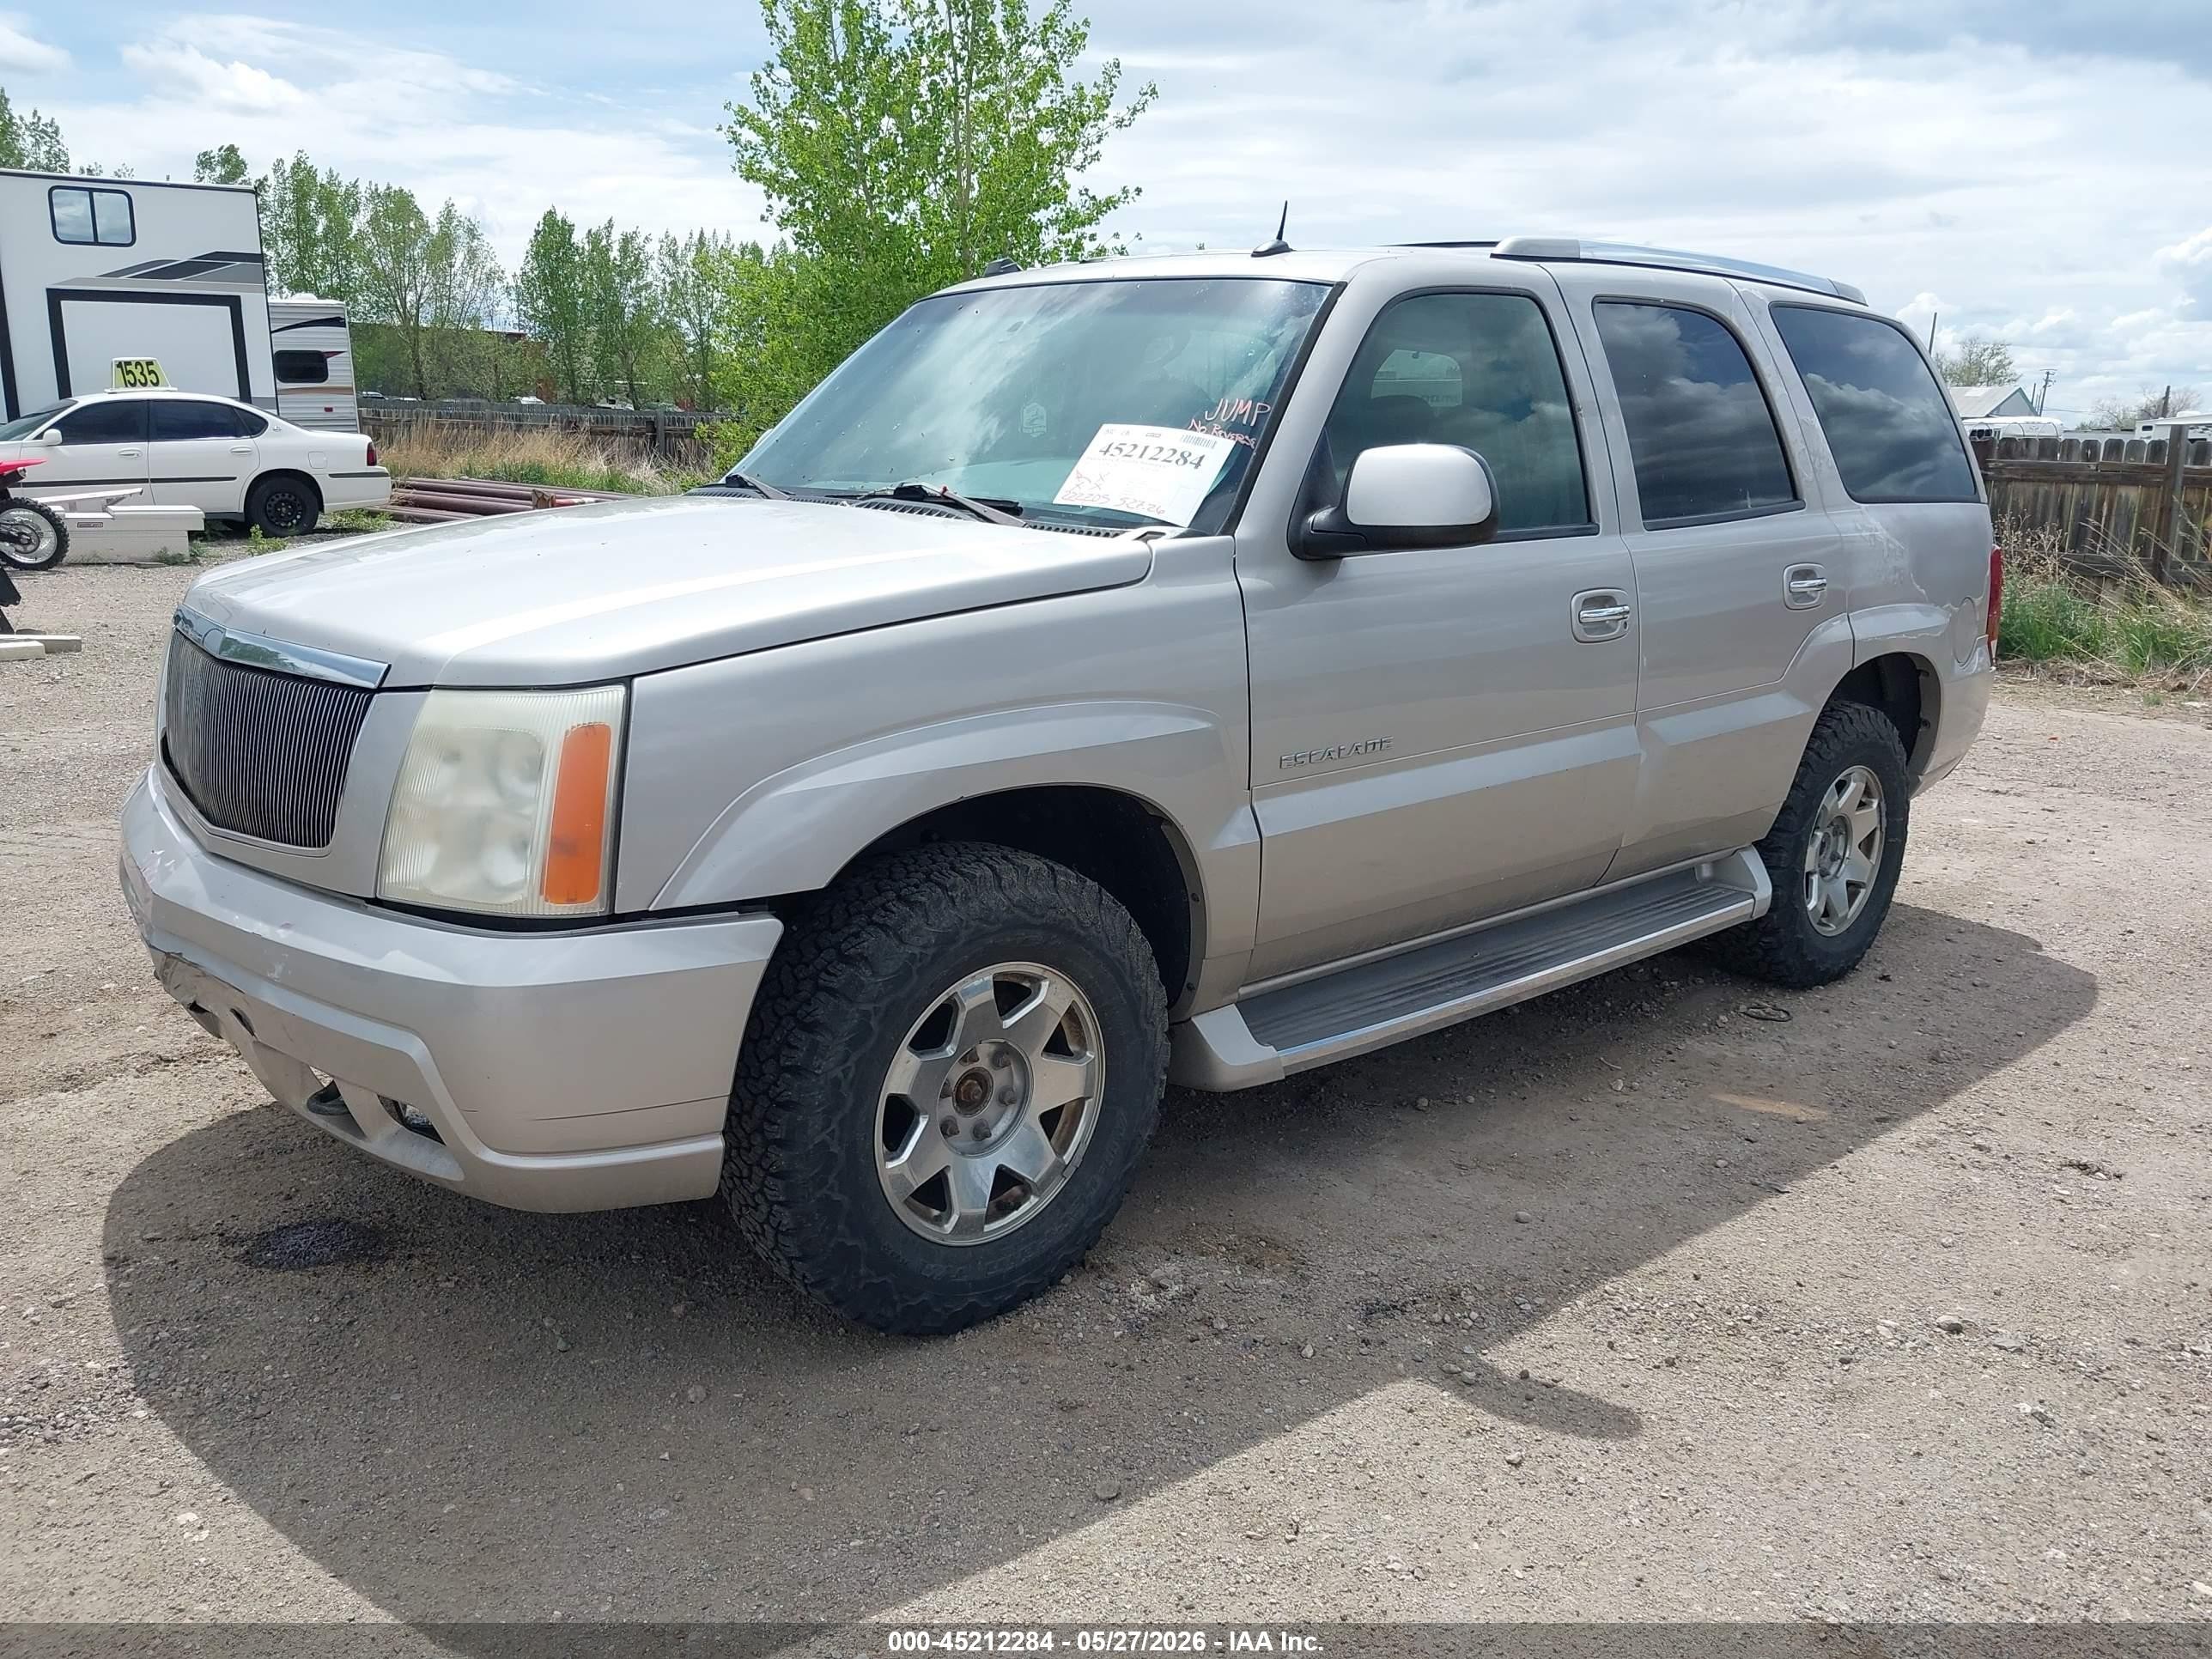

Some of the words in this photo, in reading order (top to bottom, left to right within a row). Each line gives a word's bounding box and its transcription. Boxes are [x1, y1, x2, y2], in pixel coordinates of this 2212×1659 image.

[116, 361, 160, 387] 1535
[1205, 398, 1271, 426] JUMP
[1099, 441, 1206, 470] 45212284
[1279, 736, 1394, 769] ESCALADE
